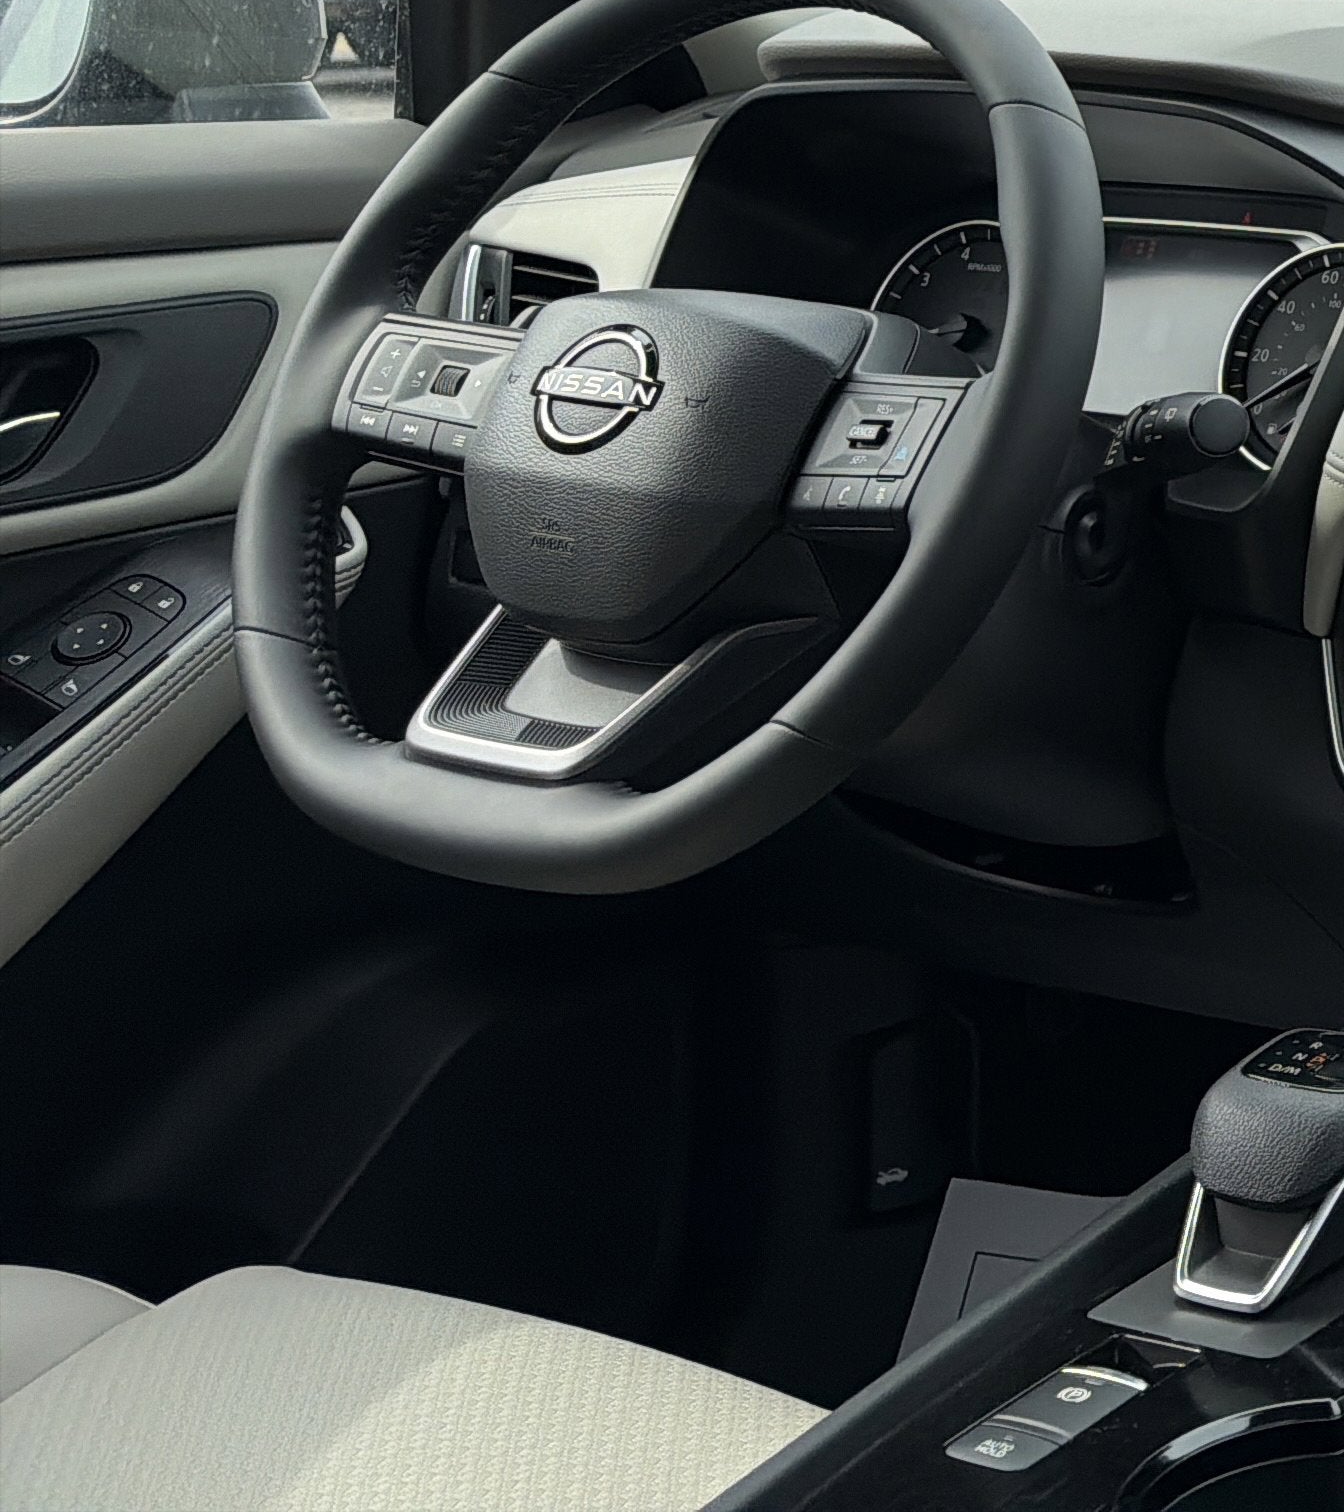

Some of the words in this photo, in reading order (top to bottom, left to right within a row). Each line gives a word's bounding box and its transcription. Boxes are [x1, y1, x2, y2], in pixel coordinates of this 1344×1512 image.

[960, 246, 971, 261] 4
[920, 272, 931, 287] 3
[1321, 270, 1339, 285] 60
[1277, 300, 1296, 314] 40
[1251, 348, 1270, 362] 20
[537, 368, 657, 406] NISSAN
[1291, 1052, 1309, 1061] N
